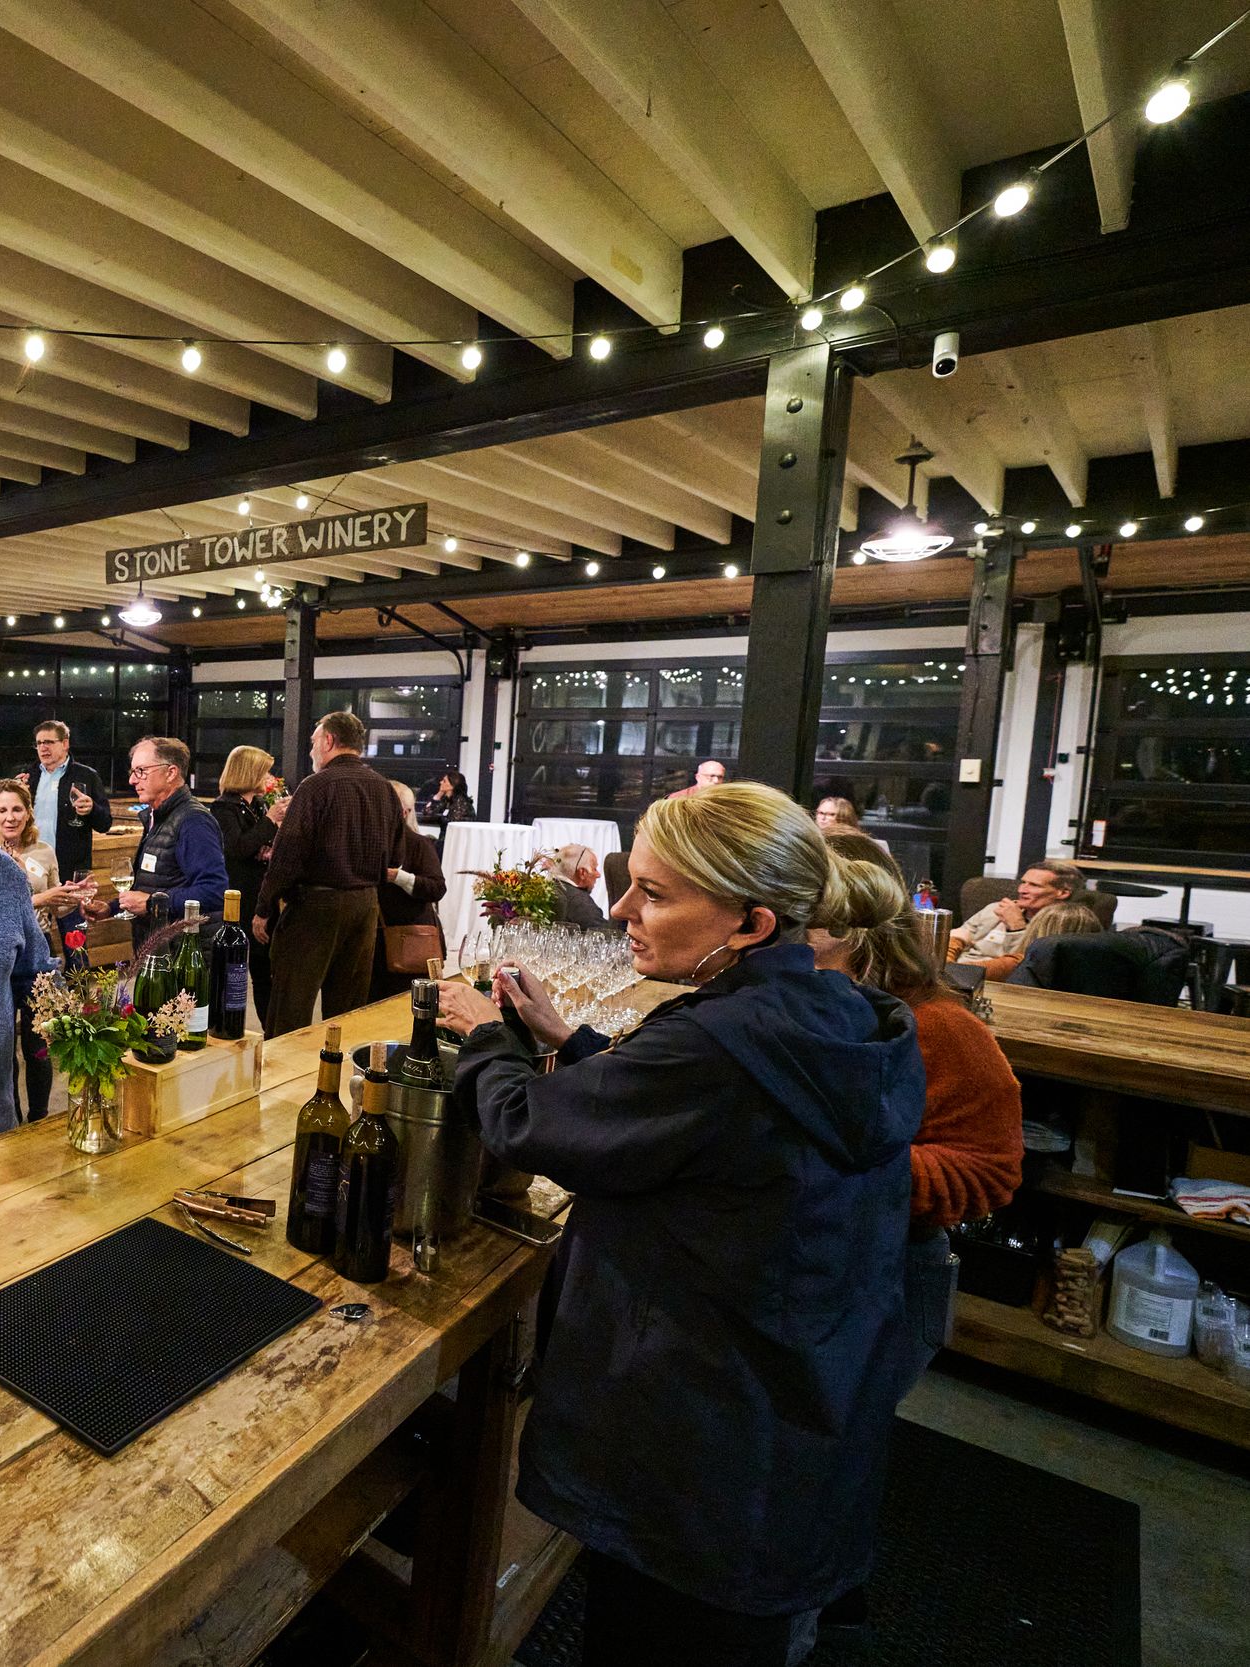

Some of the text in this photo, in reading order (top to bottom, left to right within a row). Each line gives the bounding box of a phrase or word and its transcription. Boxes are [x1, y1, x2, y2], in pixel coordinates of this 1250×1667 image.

[113, 508, 417, 583] STONE TOWER WINERY
